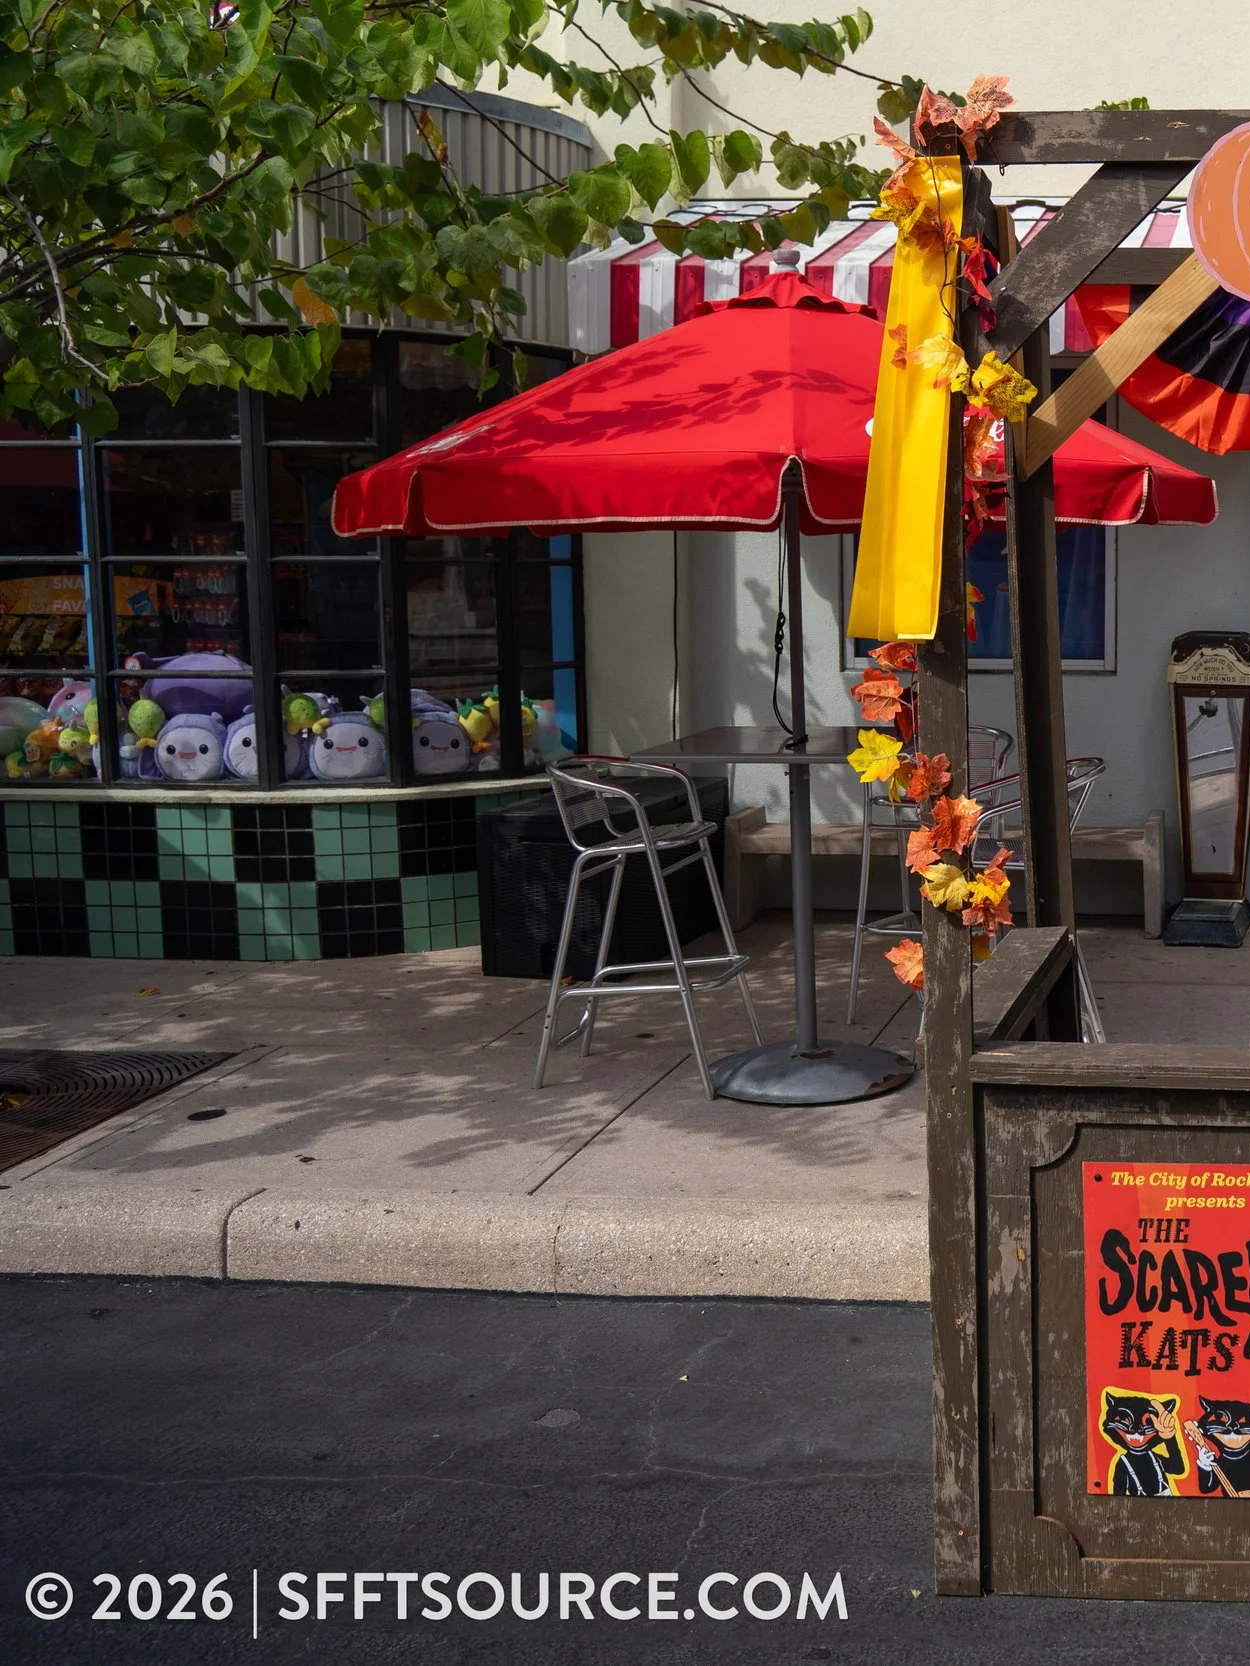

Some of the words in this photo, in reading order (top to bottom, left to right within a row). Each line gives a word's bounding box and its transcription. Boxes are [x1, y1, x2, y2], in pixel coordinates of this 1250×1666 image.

[52, 577, 84, 589] SNA
[53, 600, 87, 612] FAV
[1194, 662, 1204, 673] HOW
[1219, 658, 1226, 666] DO
[1226, 663, 1235, 673] YOU
[1111, 1171, 1145, 1186] The
[1149, 1171, 1187, 1190] City
[1190, 1172, 1210, 1188] of
[1164, 1195, 1246, 1211] presents
[1138, 1218, 1191, 1243] THE
[1118, 1321, 1241, 1377] KATS
